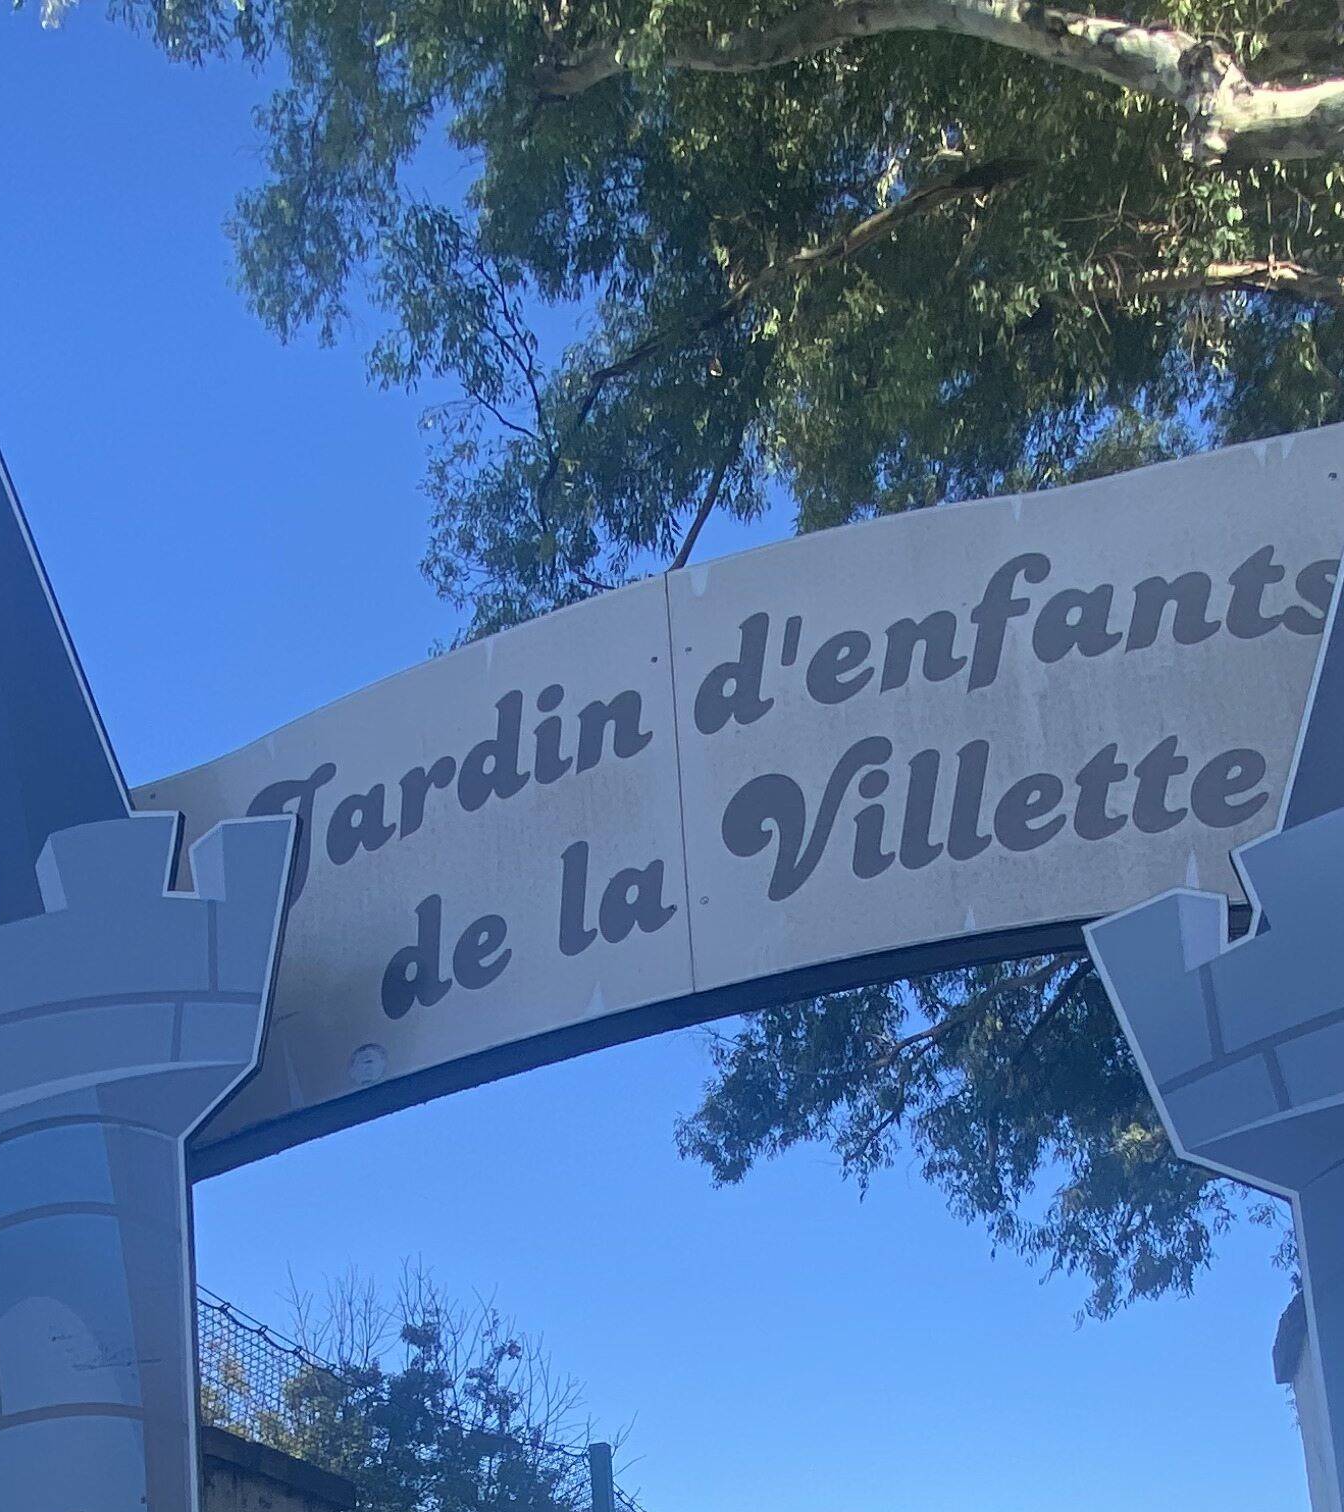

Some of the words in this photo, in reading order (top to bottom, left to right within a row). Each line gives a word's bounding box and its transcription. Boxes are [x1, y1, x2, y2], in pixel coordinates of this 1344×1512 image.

[694, 544, 1341, 735] d'enfants
[381, 893, 513, 1020] de
[559, 840, 677, 956] la
[721, 734, 1270, 902] Villette
